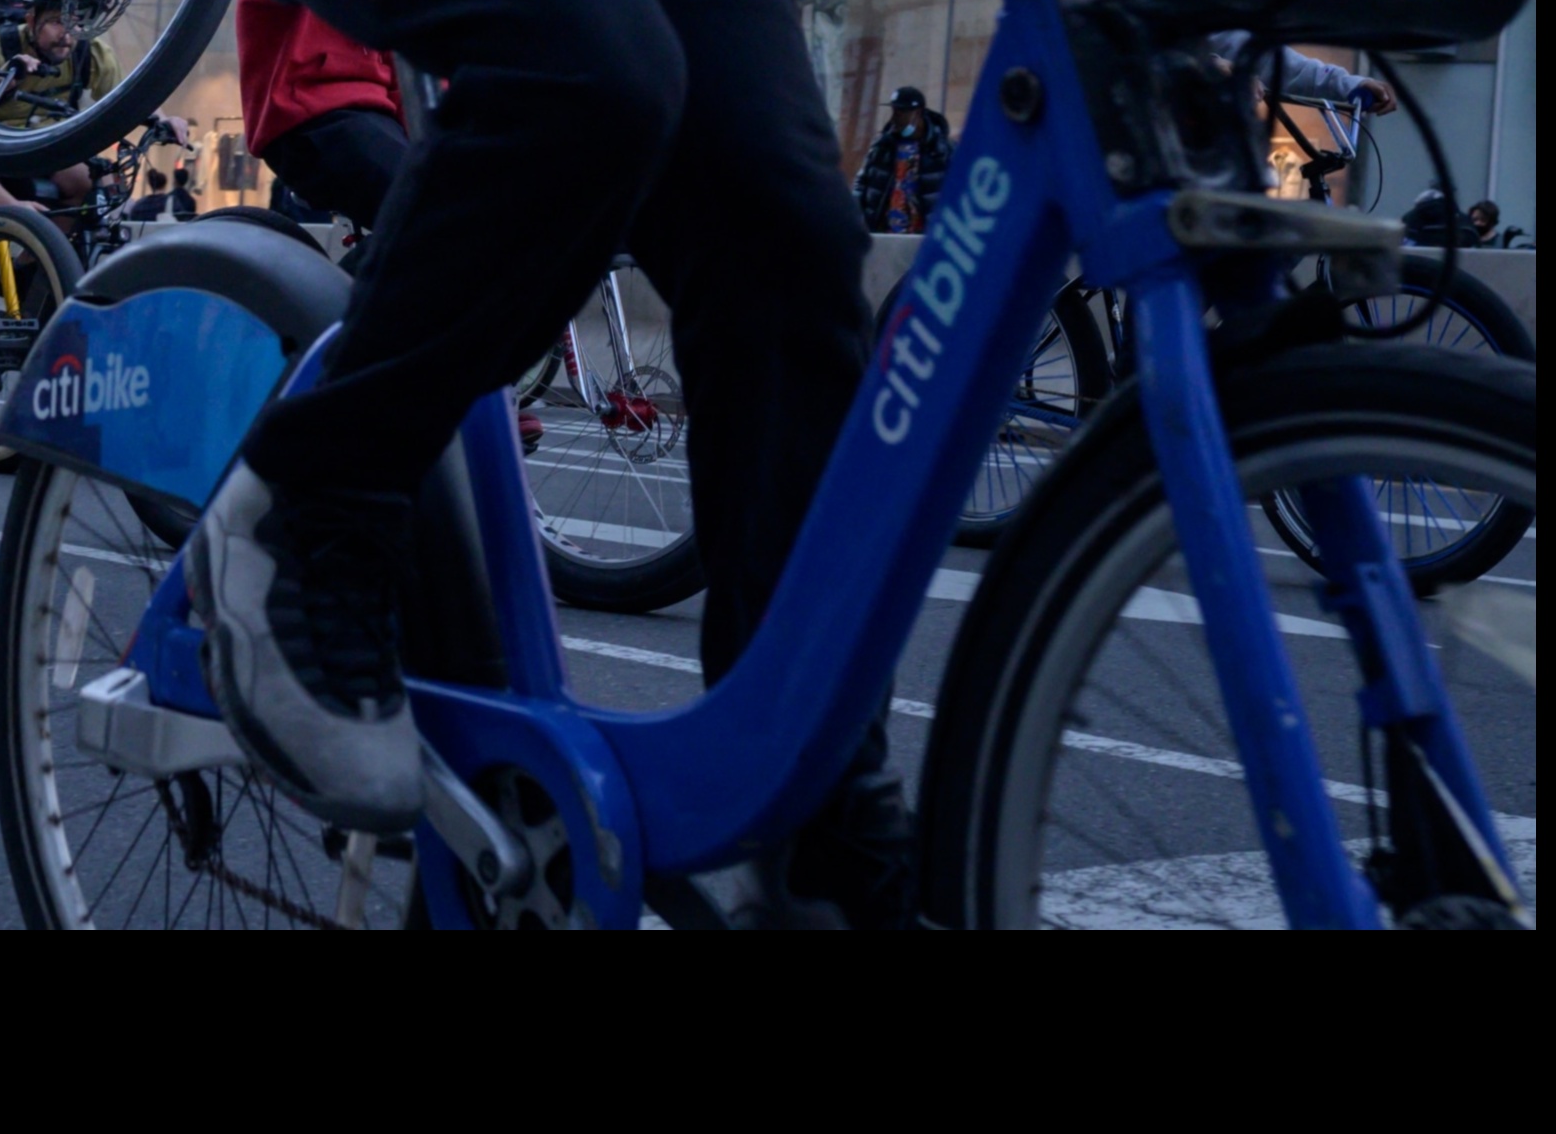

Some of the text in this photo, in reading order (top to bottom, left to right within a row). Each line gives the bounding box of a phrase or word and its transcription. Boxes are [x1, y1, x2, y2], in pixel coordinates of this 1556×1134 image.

[32, 352, 150, 420] citi bike
[873, 156, 1011, 445] citi bike
